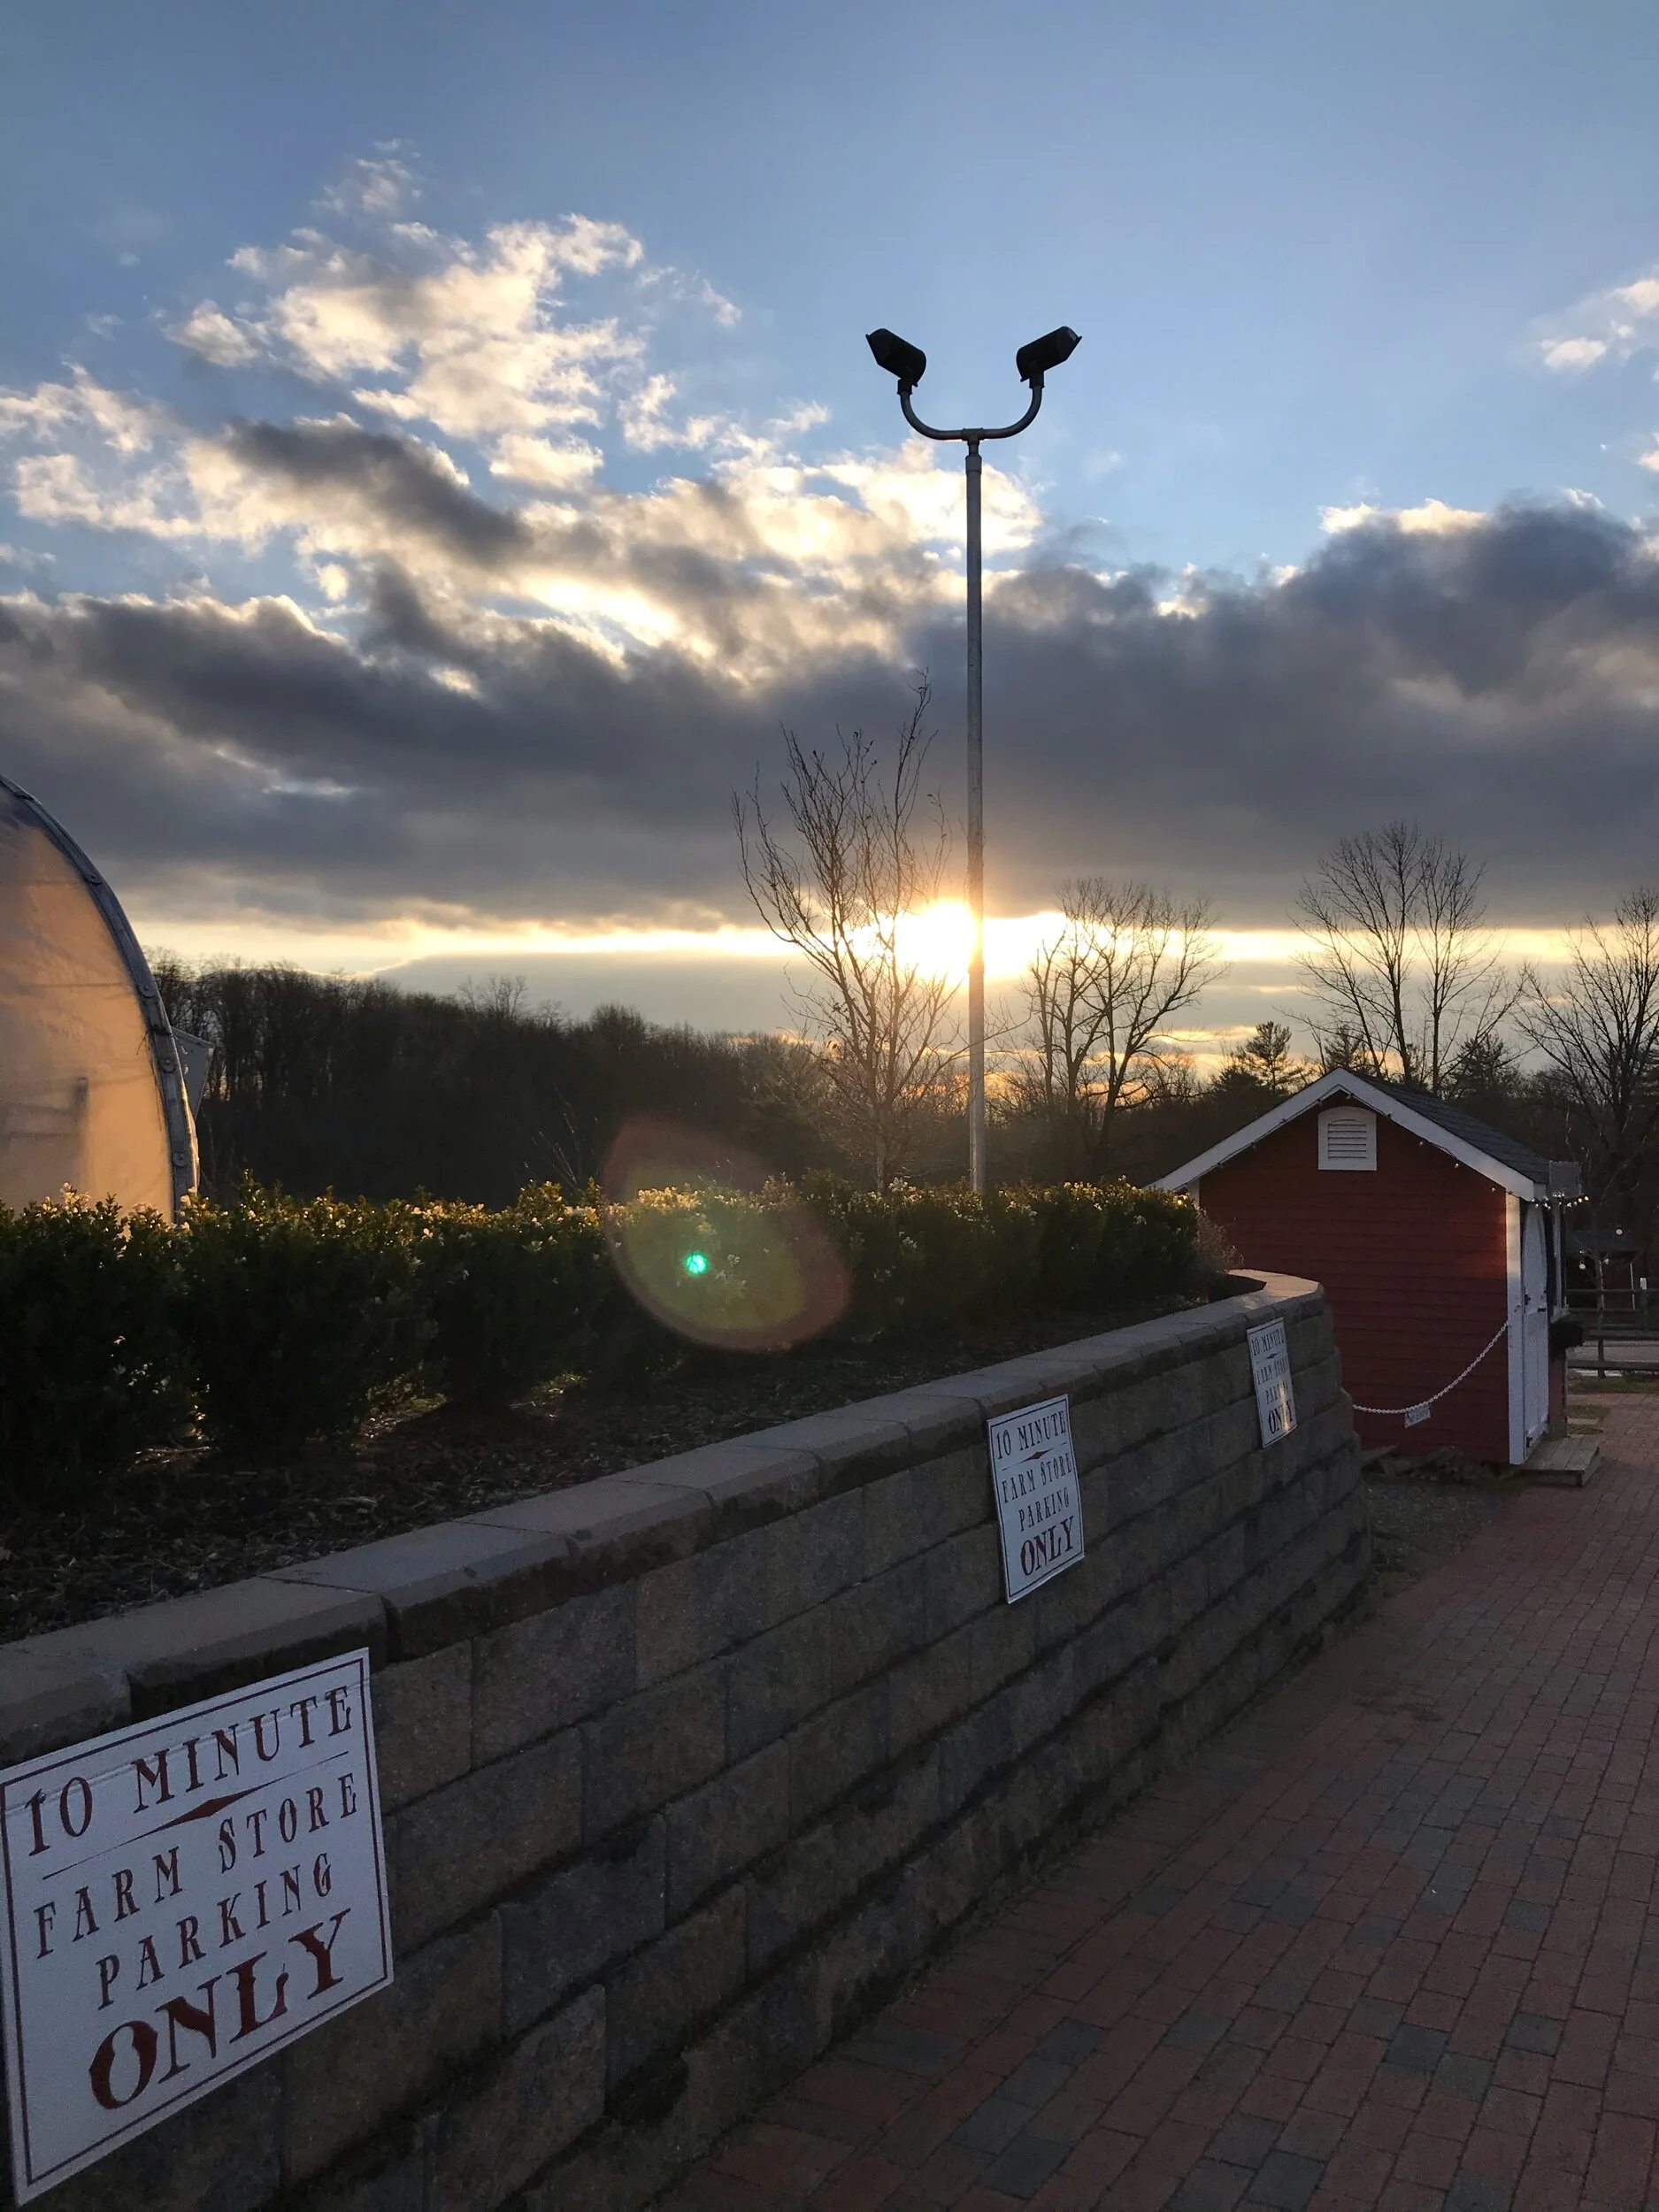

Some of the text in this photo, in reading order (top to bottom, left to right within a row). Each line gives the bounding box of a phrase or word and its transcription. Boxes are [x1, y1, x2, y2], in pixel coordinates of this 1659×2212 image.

[1251, 1338, 1260, 1356] 10
[995, 1410, 1066, 1460] 10 MINUTE
[1002, 1453, 1072, 1503] FARM STORE
[1018, 1487, 1070, 1532] PARKING
[1020, 1516, 1074, 1576] ONLY
[24, 1686, 352, 1856] 10 MINUTE
[35, 1773, 357, 1959] FARM STORE
[96, 1852, 331, 2010] PARKING
[88, 1908, 351, 2109] ONLY
